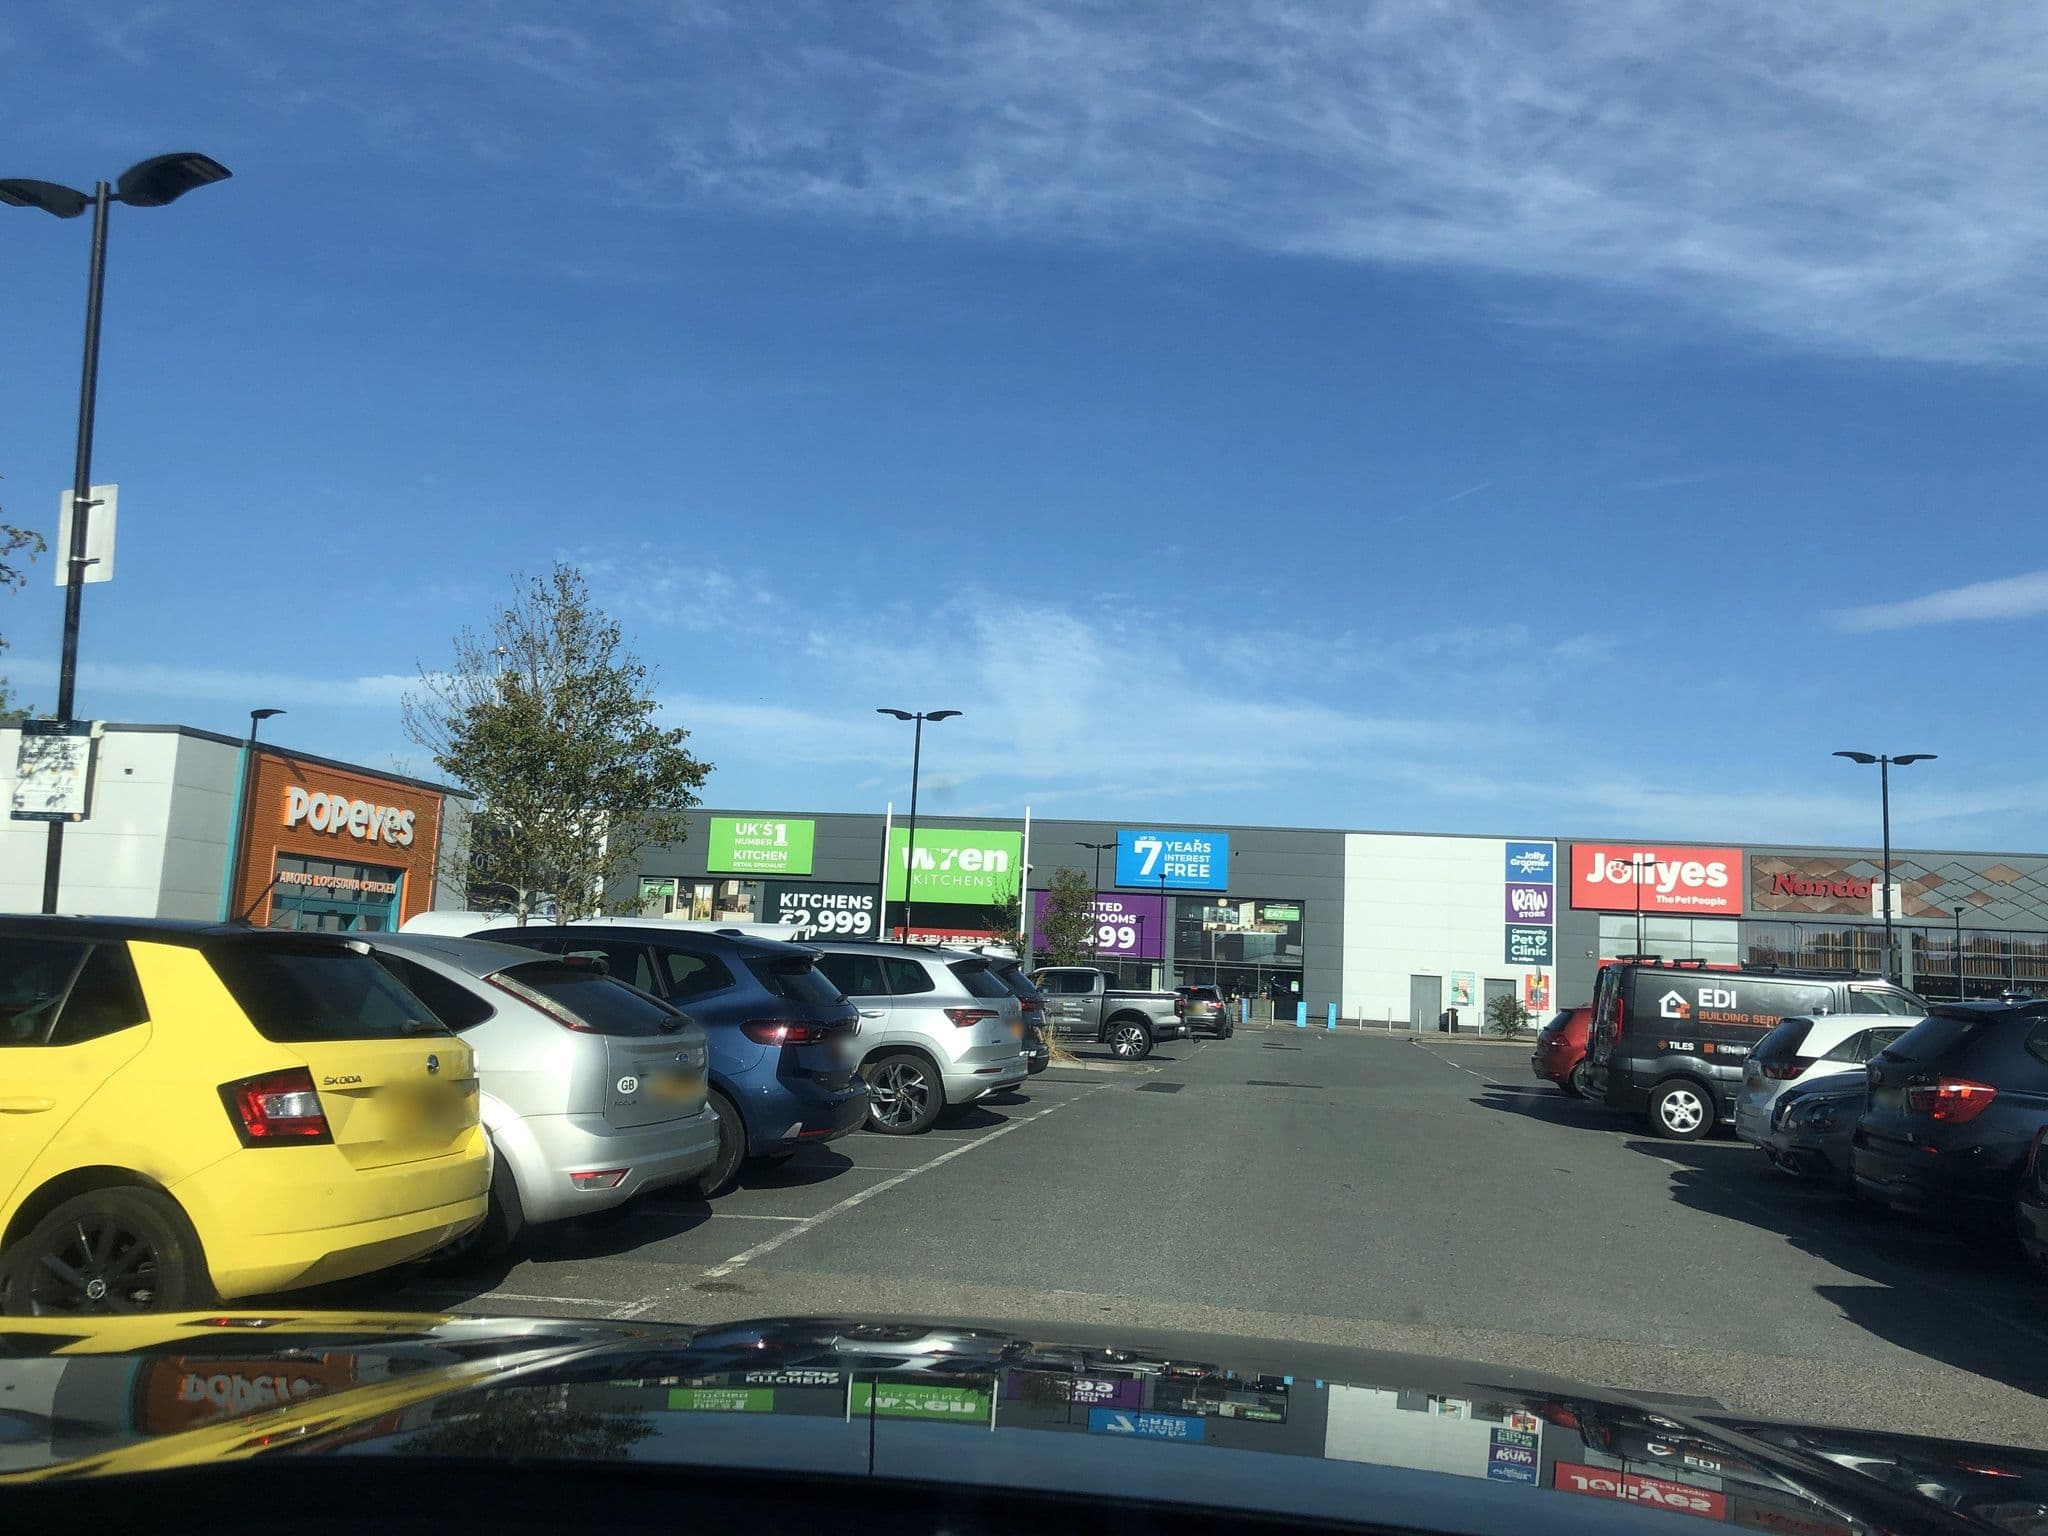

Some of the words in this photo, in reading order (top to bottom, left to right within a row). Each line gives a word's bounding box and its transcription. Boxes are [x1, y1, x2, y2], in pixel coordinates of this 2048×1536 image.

[735, 822, 773, 836] UK'S
[774, 823, 788, 847] 1
[735, 837, 773, 846] NUMBER
[733, 849, 788, 861] KITCHEN
[902, 847, 1009, 872] wren
[1134, 840, 1163, 876] 7
[1166, 841, 1212, 853] YEARS
[1164, 854, 1211, 863] INTEREST
[1510, 858, 1550, 867] Groomer
[1164, 862, 1210, 878] FREE
[1586, 852, 1729, 893] Jollyes
[278, 871, 312, 886] AMOUS
[912, 874, 993, 887] KITCHENS
[1770, 872, 1879, 899] Nando'
[780, 892, 873, 910] KITCHENS
[1511, 889, 1548, 911] RAW
[1656, 895, 1675, 904] The
[1675, 896, 1692, 905] Pet
[1692, 897, 1727, 907] People
[1511, 928, 1547, 936] Community
[1511, 934, 1534, 945] Pet
[1511, 945, 1548, 956] Clinic
[1698, 988, 1737, 1009] EDI
[1698, 1011, 1749, 1023] BUILDING
[1752, 1014, 1784, 1025] SERV
[1668, 1041, 1695, 1051] TILES
[621, 1079, 635, 1091] GB
